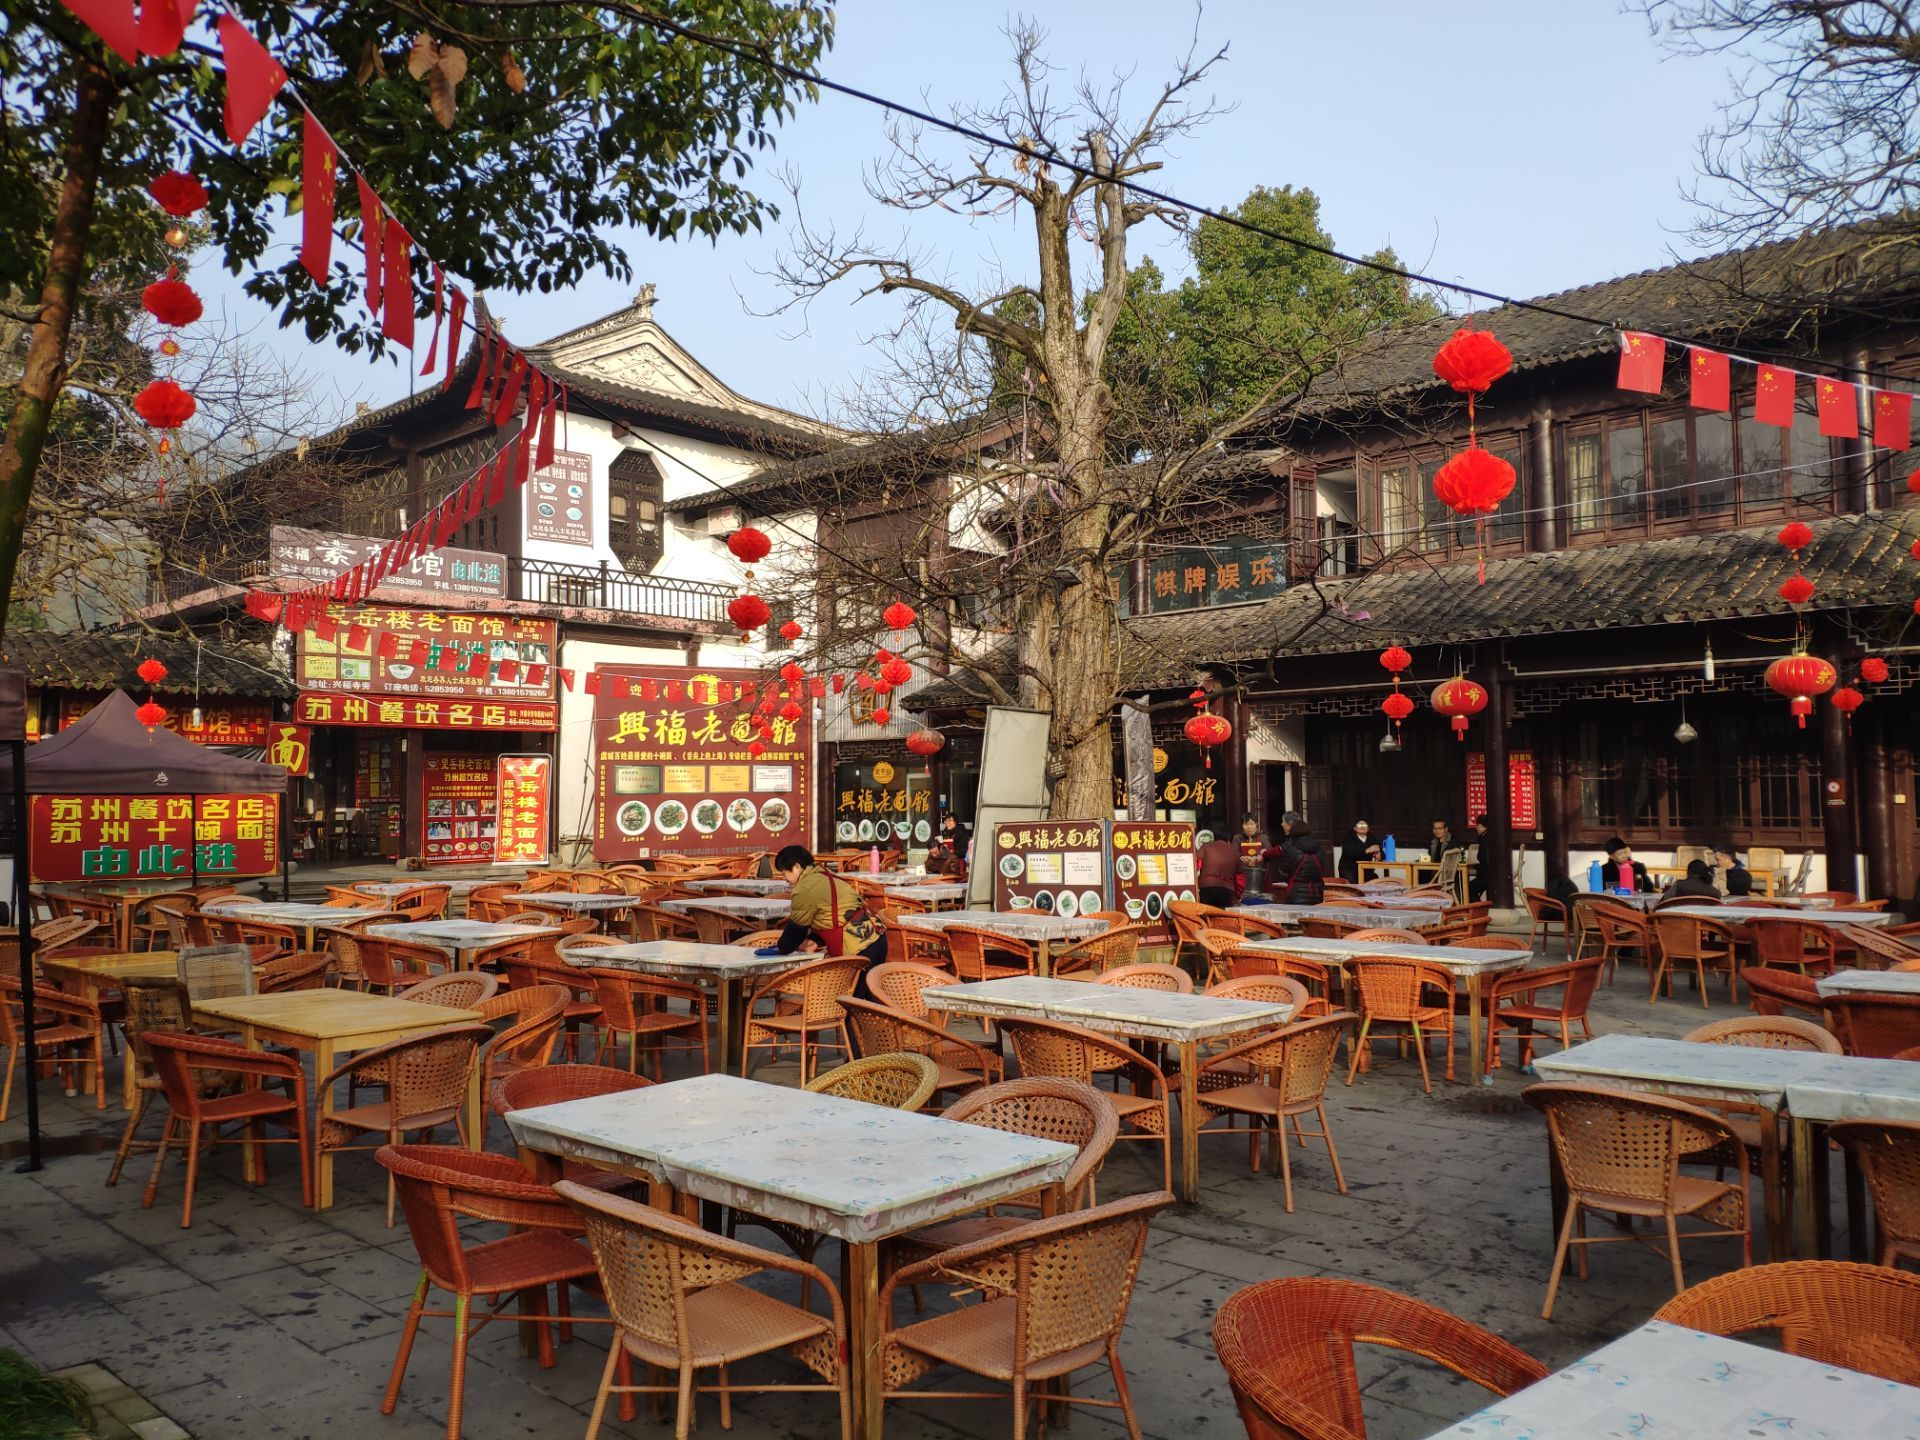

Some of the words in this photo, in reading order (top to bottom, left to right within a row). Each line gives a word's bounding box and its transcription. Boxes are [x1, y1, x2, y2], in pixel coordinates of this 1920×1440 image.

[278, 545, 311, 562] 兴福
[451, 558, 501, 584] 由此进
[1154, 555, 1276, 598] 棋牌娱乐
[305, 697, 506, 726] 苏州餐饮名店
[270, 727, 306, 773] 面
[444, 772, 489, 782] 苏州餐饮名店
[50, 798, 265, 820] 苏州餐饮名店
[513, 762, 542, 855] 望岳楼老面馆
[50, 820, 264, 844] 苏州十碗面
[81, 843, 238, 876] 由此进
